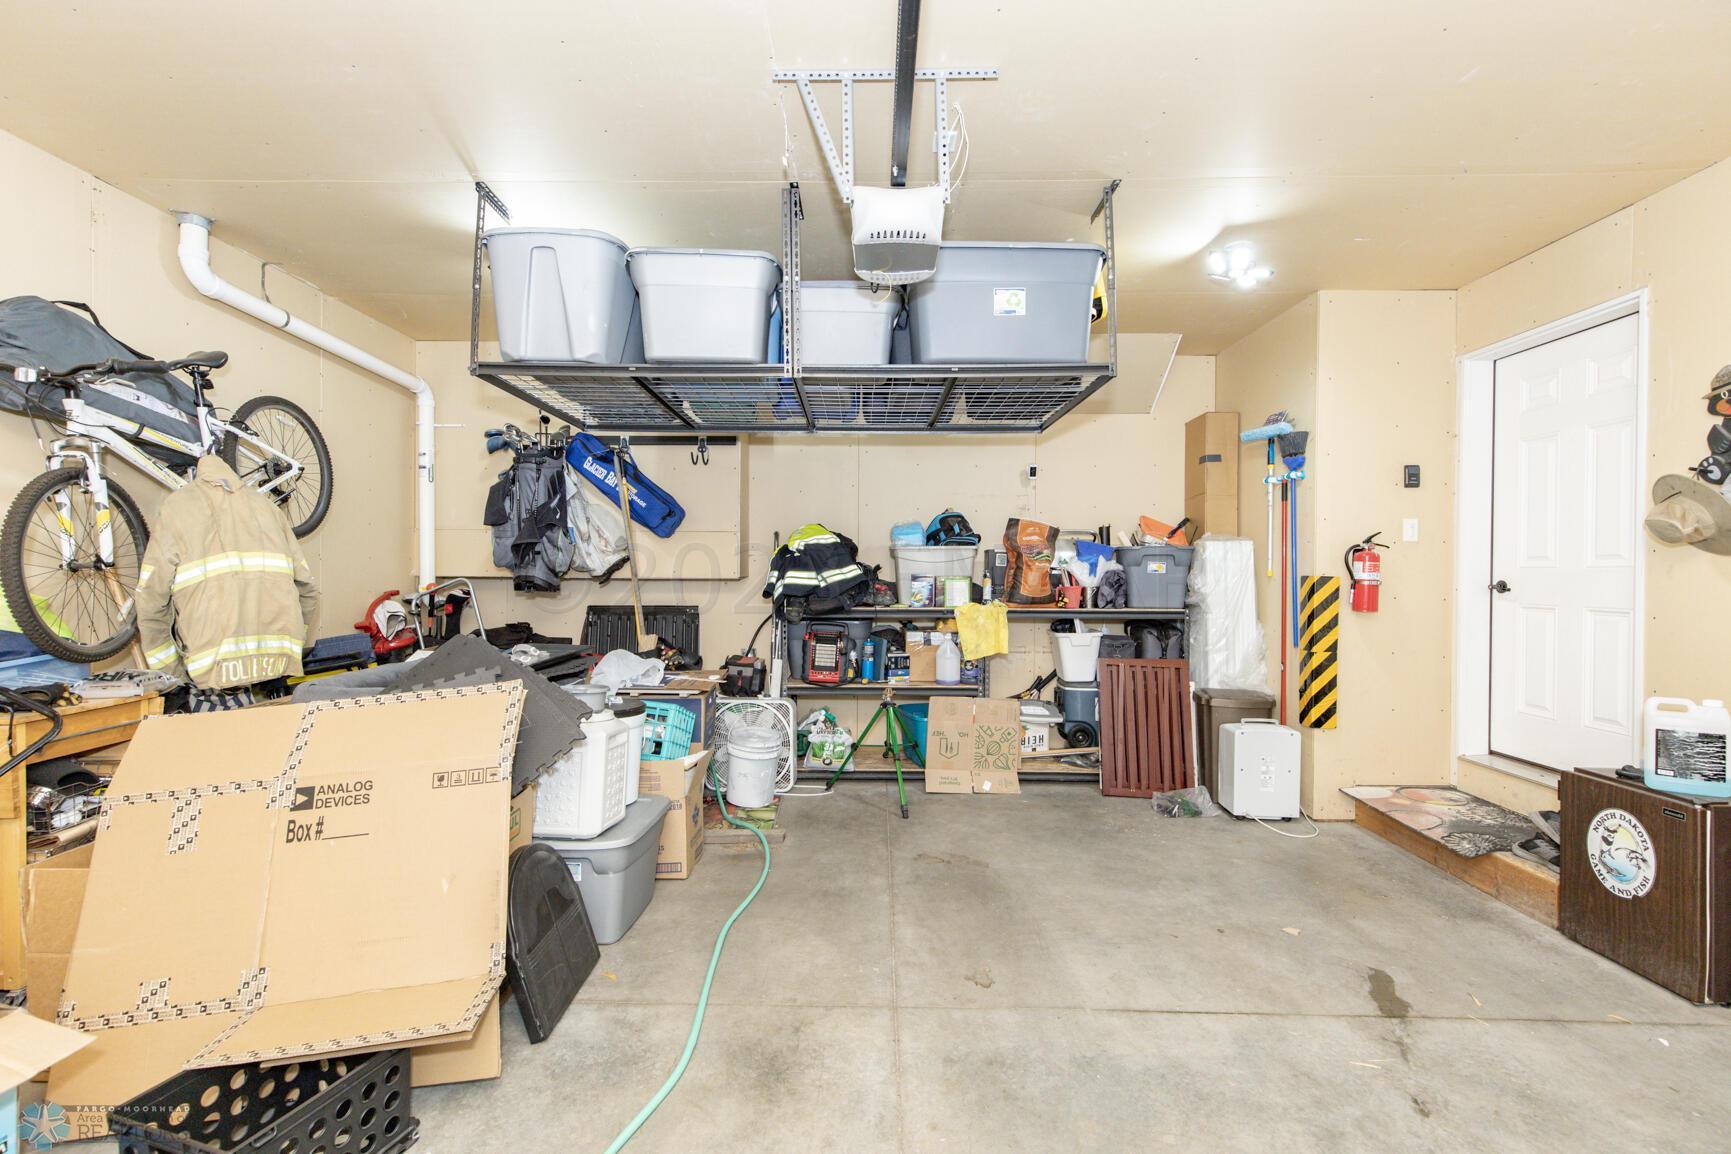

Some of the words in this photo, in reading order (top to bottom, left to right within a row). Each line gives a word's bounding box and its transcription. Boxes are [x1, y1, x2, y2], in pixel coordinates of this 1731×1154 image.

[583, 456, 608, 481] GLACIER
[317, 780, 374, 796] ANALOG
[315, 793, 371, 810] DEVICES
[286, 819, 313, 844] Box
[1592, 811, 1617, 833] NORTH
[1619, 813, 1650, 852] DAKOTA
[1590, 853, 1608, 885] GAME
[1609, 884, 1632, 897] AND
[1633, 875, 1651, 895] FISH
